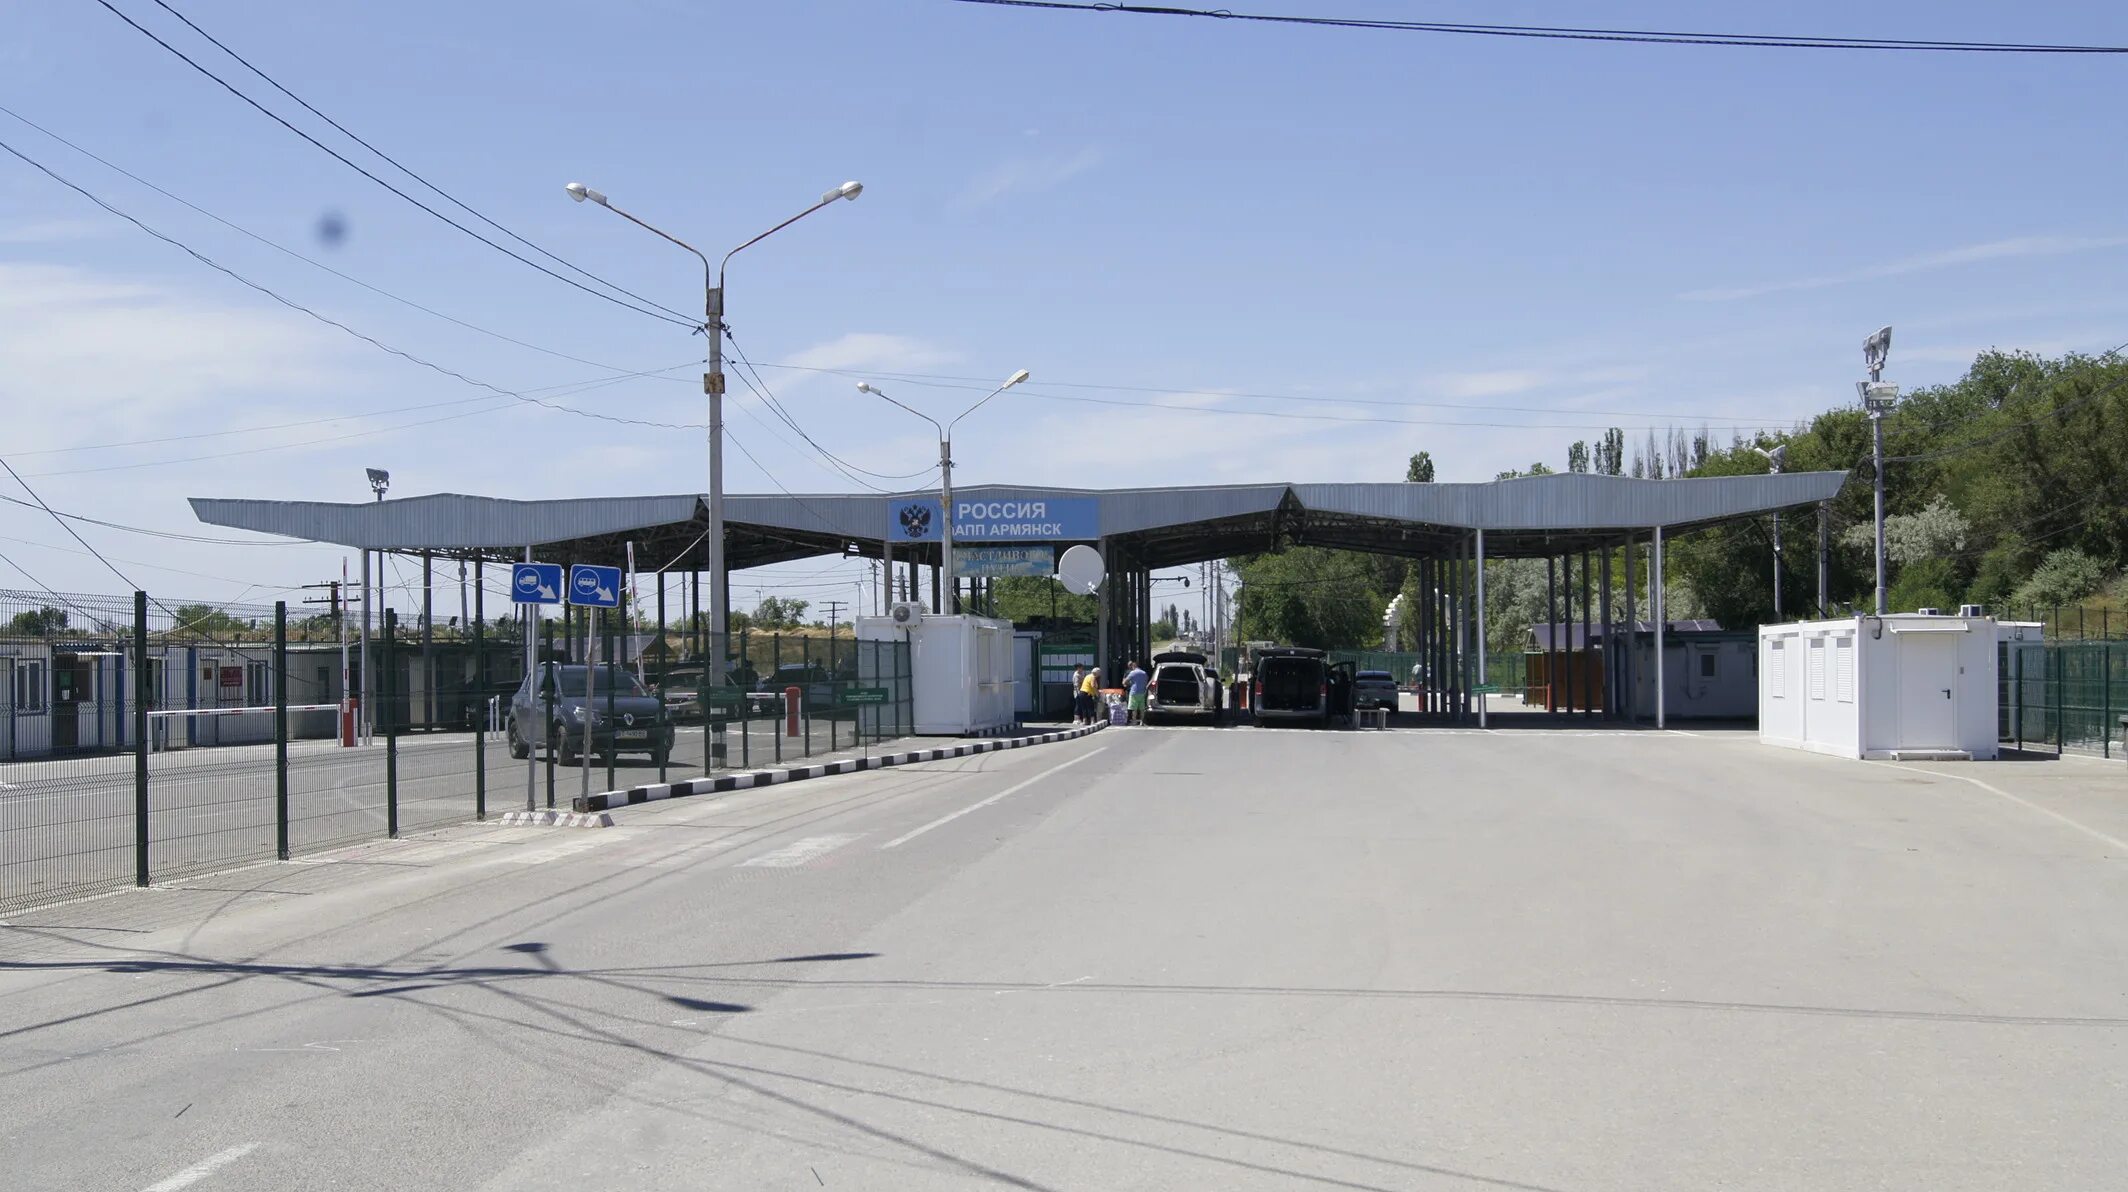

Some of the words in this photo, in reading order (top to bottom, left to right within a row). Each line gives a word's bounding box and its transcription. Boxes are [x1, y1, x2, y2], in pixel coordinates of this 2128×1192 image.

[958, 502, 1046, 519] РОССИЯ
[951, 524, 985, 536] АПП
[990, 523, 1062, 536] АРМЯНСК
